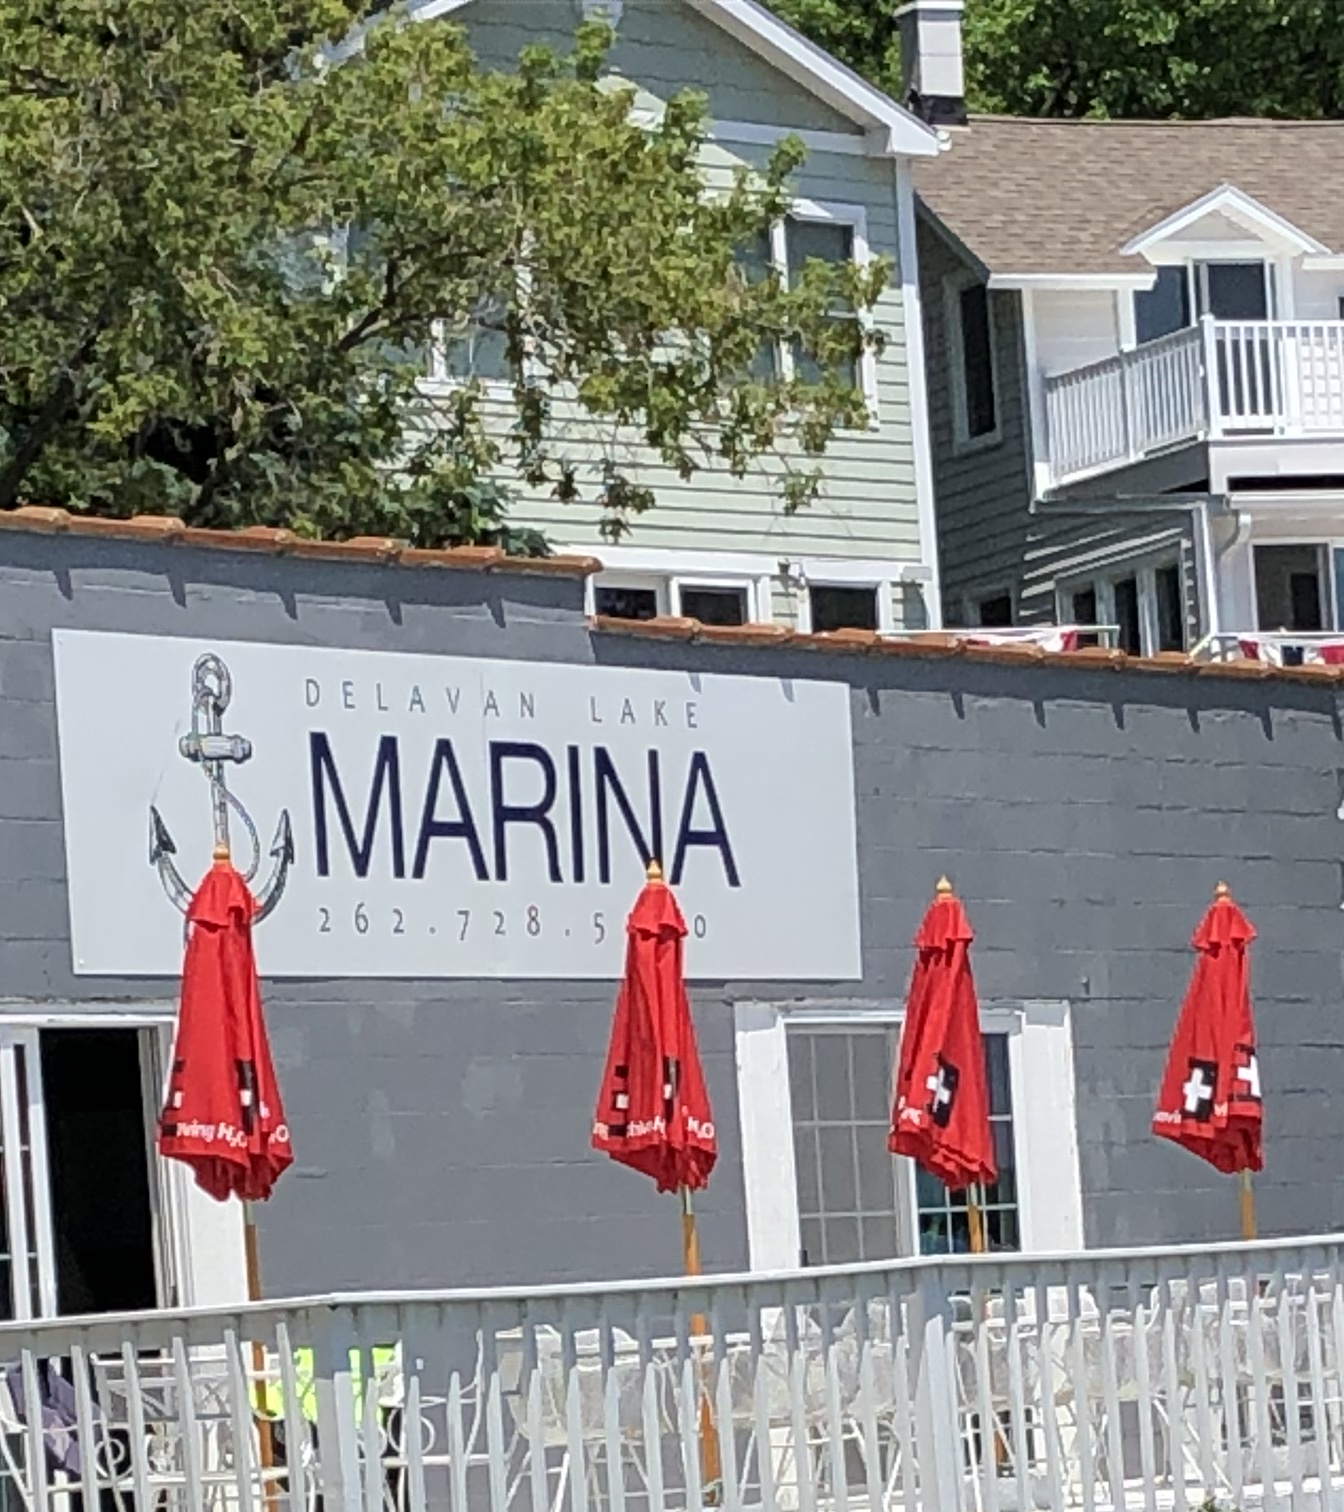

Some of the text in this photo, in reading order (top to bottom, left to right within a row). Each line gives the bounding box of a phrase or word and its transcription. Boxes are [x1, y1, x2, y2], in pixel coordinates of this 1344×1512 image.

[305, 678, 698, 729] DELAVAN LAKE
[309, 731, 742, 888] MARINA
[318, 902, 708, 945] 262.728.50
